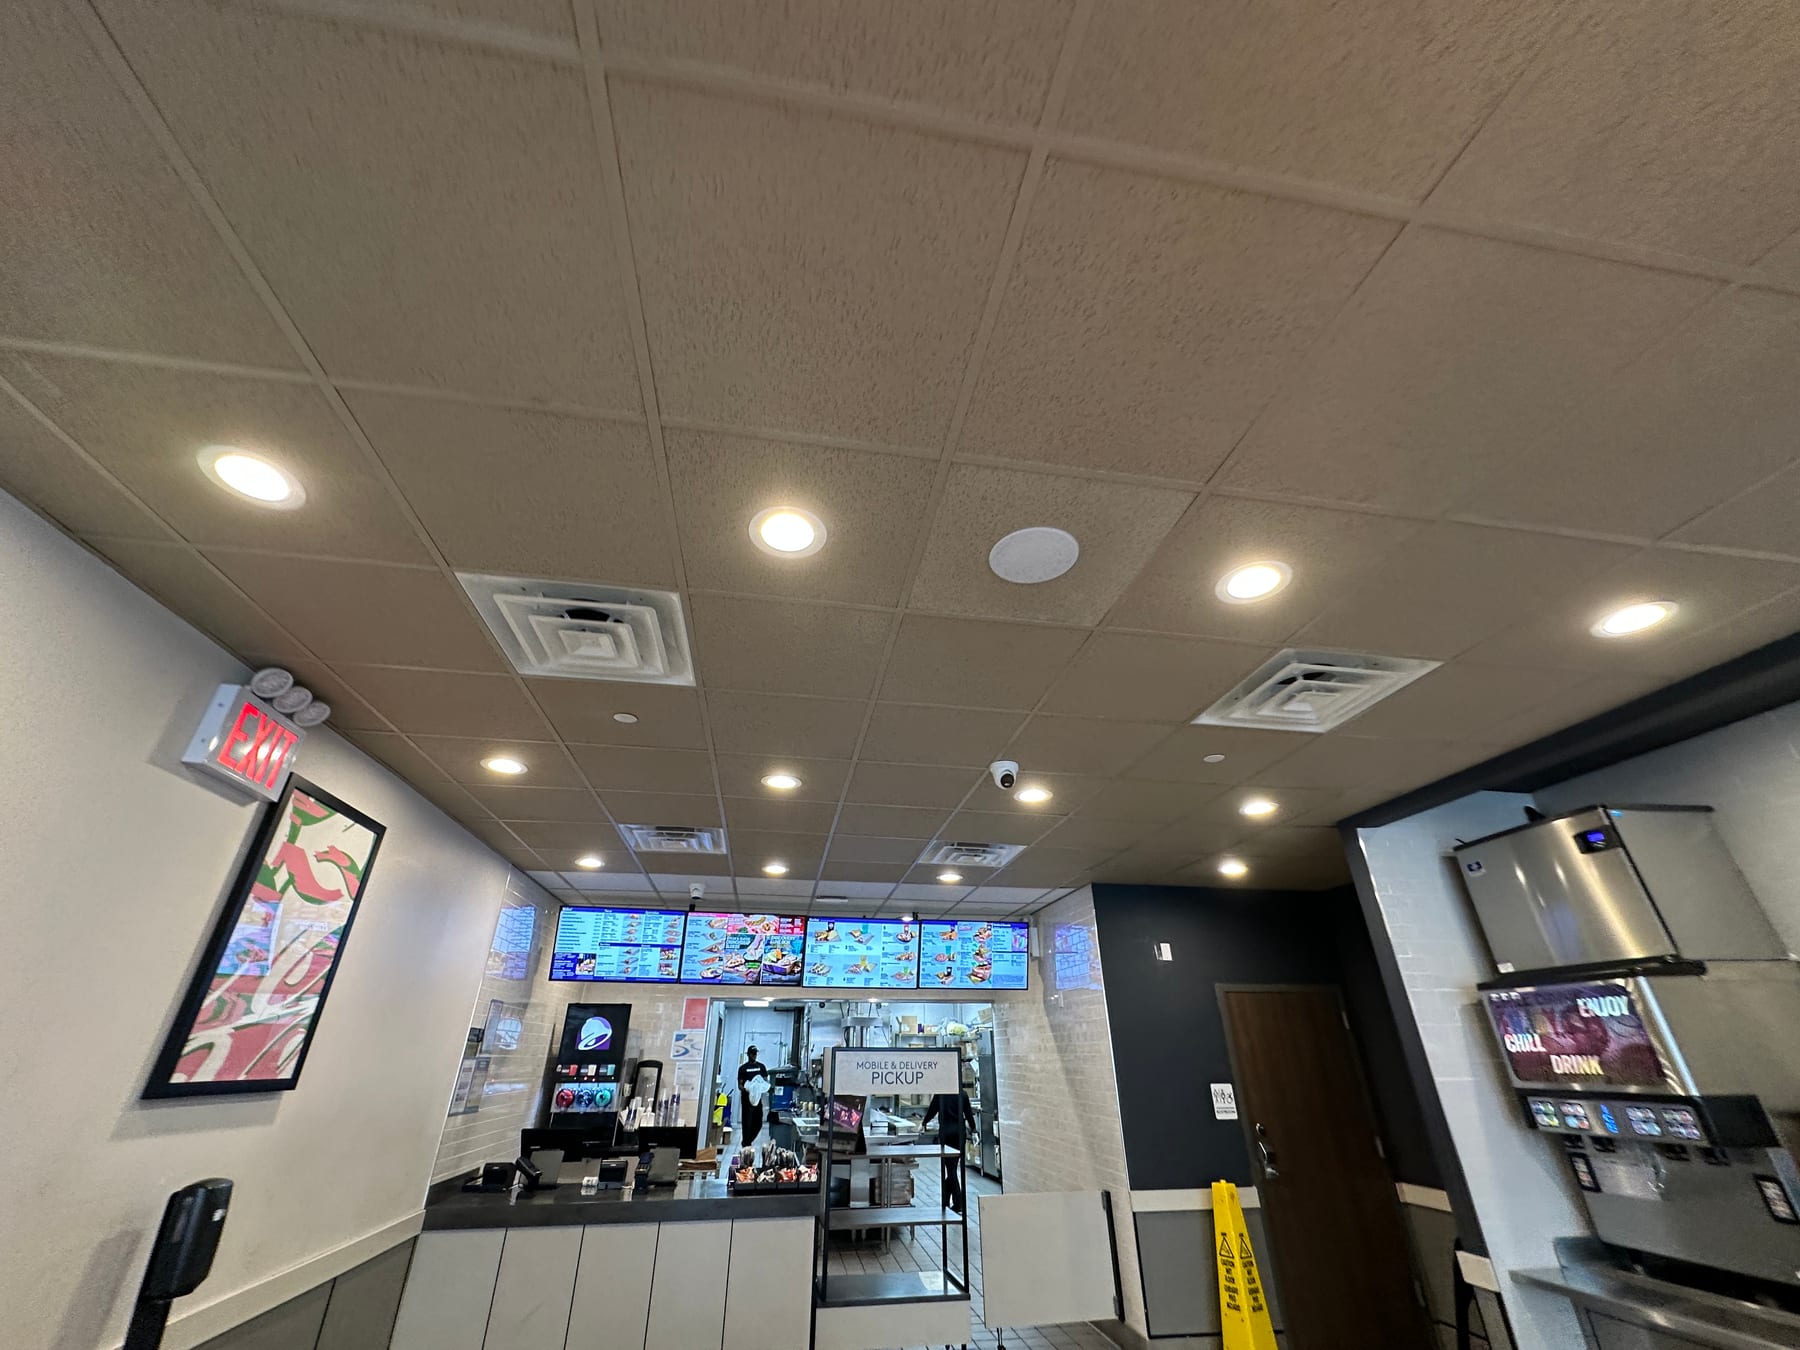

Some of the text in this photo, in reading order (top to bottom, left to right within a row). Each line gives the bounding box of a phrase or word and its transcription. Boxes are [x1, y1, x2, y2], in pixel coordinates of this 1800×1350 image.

[217, 702, 299, 790] EXIT
[1576, 995, 1629, 1018] ENJOY
[1504, 1032, 1547, 1053] CHILL
[856, 1061, 938, 1070] MOBILE & DELIVERY
[1549, 1054, 1605, 1076] DRINK
[871, 1071, 924, 1085] PICKUP
